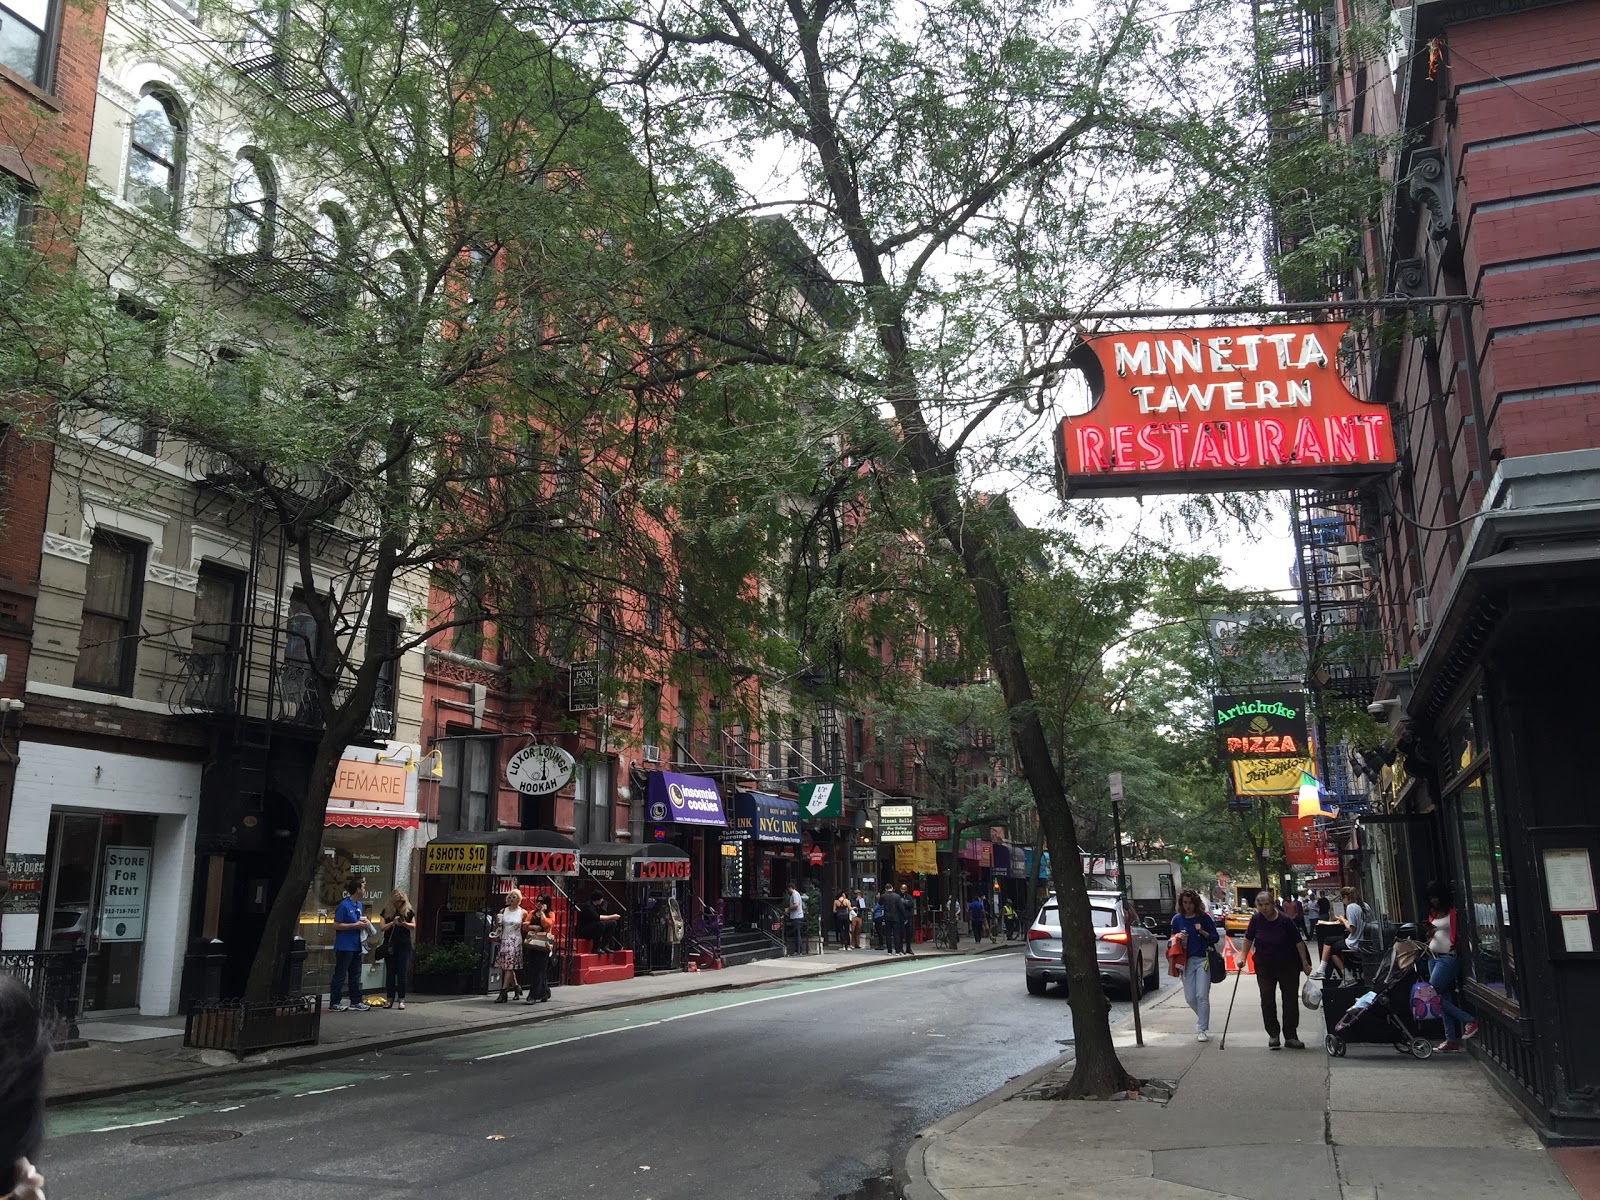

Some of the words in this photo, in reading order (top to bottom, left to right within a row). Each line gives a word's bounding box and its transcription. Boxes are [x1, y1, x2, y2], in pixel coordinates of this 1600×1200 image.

[1114, 333, 1328, 377] MINETTA
[1131, 378, 1313, 414] TAVERN
[1076, 413, 1388, 472] RESTAURANT
[1217, 700, 1296, 725] Artichoke
[1227, 735, 1297, 754] PIZZA
[509, 747, 535, 775] LUXOR
[538, 746, 569, 774] LOUNGE
[519, 778, 558, 792] HOOKAH
[681, 784, 718, 800] insomnia
[687, 799, 719, 812] cookies
[737, 818, 753, 828] INK
[759, 817, 780, 833] NYC
[782, 820, 799, 834] INK
[109, 854, 145, 866] STORE
[429, 847, 434, 860] 4
[436, 848, 464, 860] SHOTS
[469, 847, 485, 861] $10
[514, 850, 576, 872] LUXOR
[350, 865, 381, 873] BEIGNETS
[429, 863, 456, 871] EVERY
[457, 863, 483, 872] NIGHT
[581, 858, 622, 867] Restaurant
[114, 869, 137, 881] FOR
[588, 868, 615, 878] Lounge
[639, 861, 691, 879] LOUNGE
[109, 884, 139, 896] RENT
[369, 891, 383, 899] LAIT
